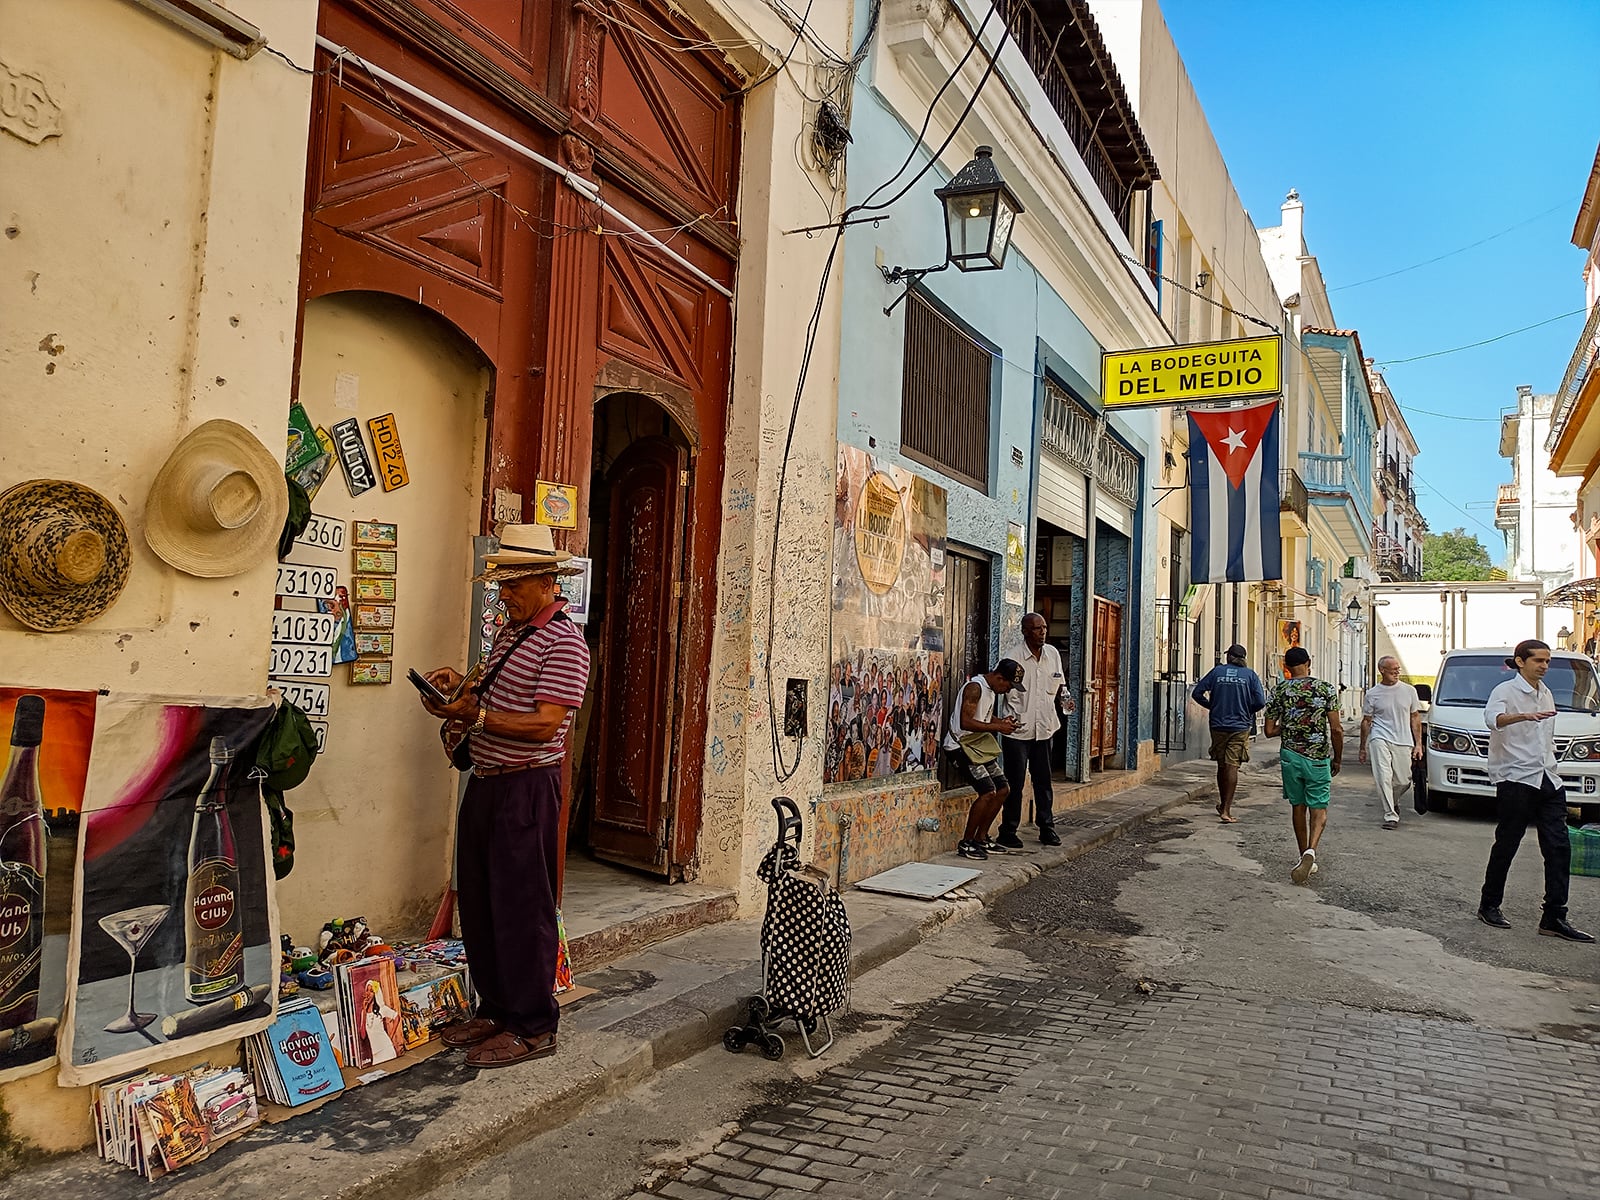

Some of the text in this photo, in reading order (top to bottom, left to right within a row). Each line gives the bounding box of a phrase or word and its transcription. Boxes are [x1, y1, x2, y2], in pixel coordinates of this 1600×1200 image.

[1119, 349, 1262, 375] LA BODEGUITA
[1119, 367, 1262, 396] DEL MEDIO
[336, 422, 370, 489] HUL107
[394, 438, 402, 460] CUBA
[193, 890, 235, 907] Havana
[279, 1032, 322, 1055] Havana
[292, 1047, 318, 1063] Club
[306, 1069, 313, 1080] 3
